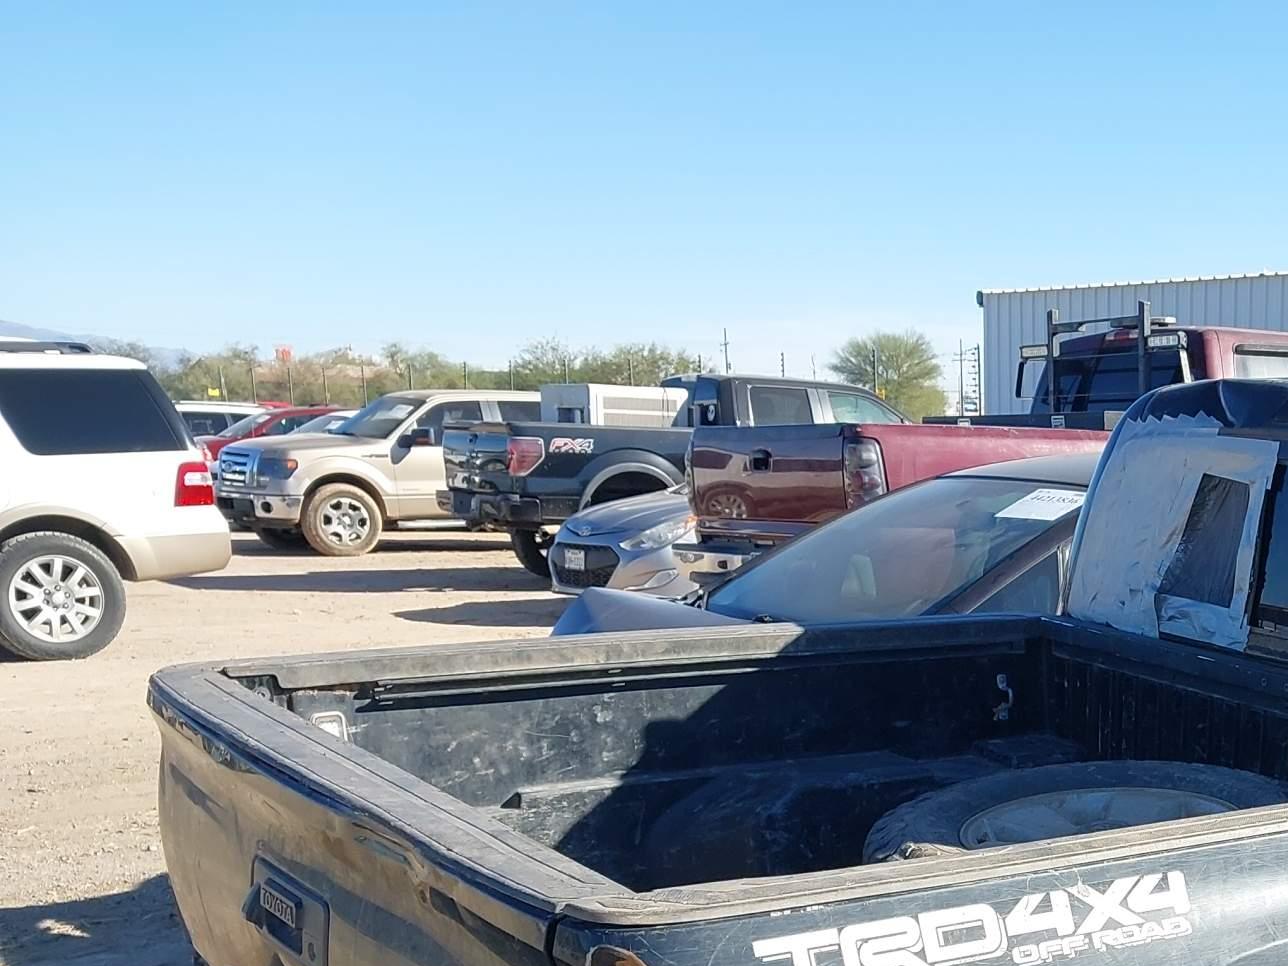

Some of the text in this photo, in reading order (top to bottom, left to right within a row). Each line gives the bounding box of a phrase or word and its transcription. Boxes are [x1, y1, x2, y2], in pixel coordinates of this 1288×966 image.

[550, 437, 594, 450] FX4
[261, 886, 296, 927] TOYOTA
[1012, 917, 1193, 966] OFF ROAD
